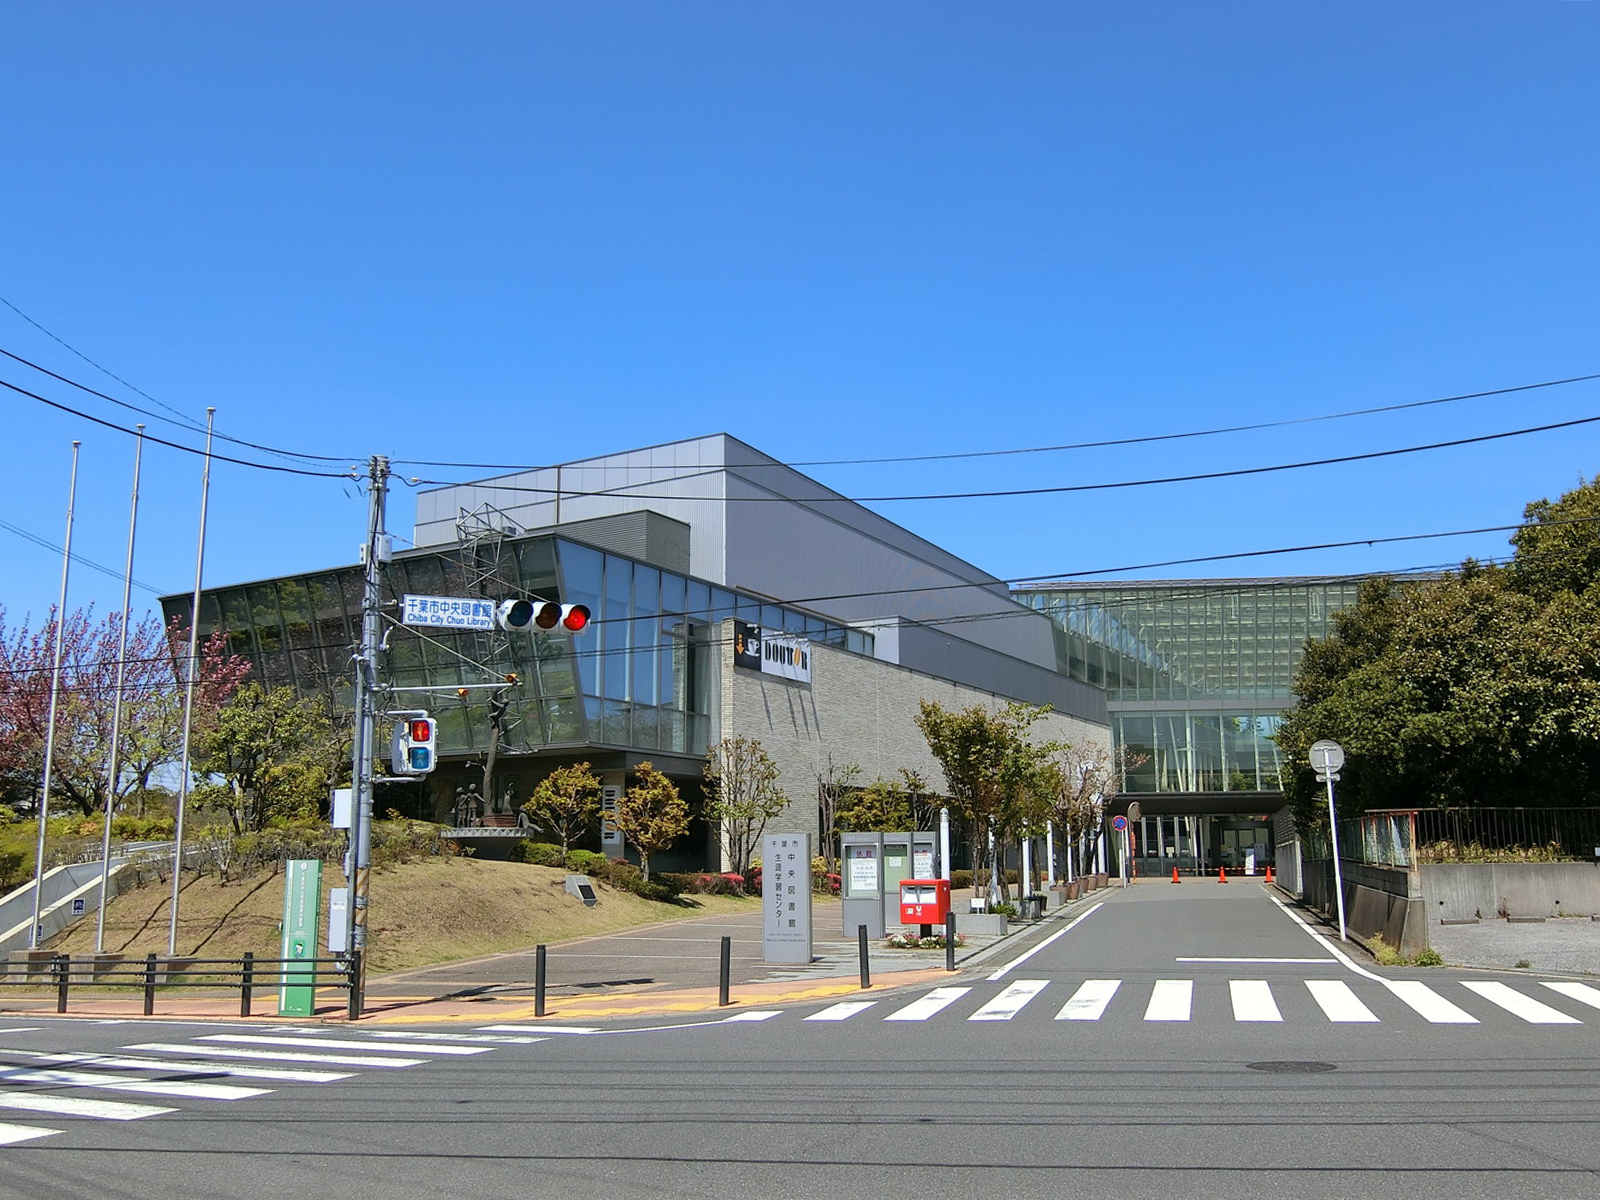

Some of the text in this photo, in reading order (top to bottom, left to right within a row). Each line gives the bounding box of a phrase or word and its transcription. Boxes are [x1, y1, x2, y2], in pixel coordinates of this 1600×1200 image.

[408, 599, 492, 617] 千葉市中央図書館
[407, 613, 491, 628] Chiba City Chuo Library
[764, 640, 808, 671] DOUTOR
[771, 840, 799, 848] 千葉市
[774, 853, 783, 928] 生涯学習センター
[787, 853, 796, 928] 中央図書館
